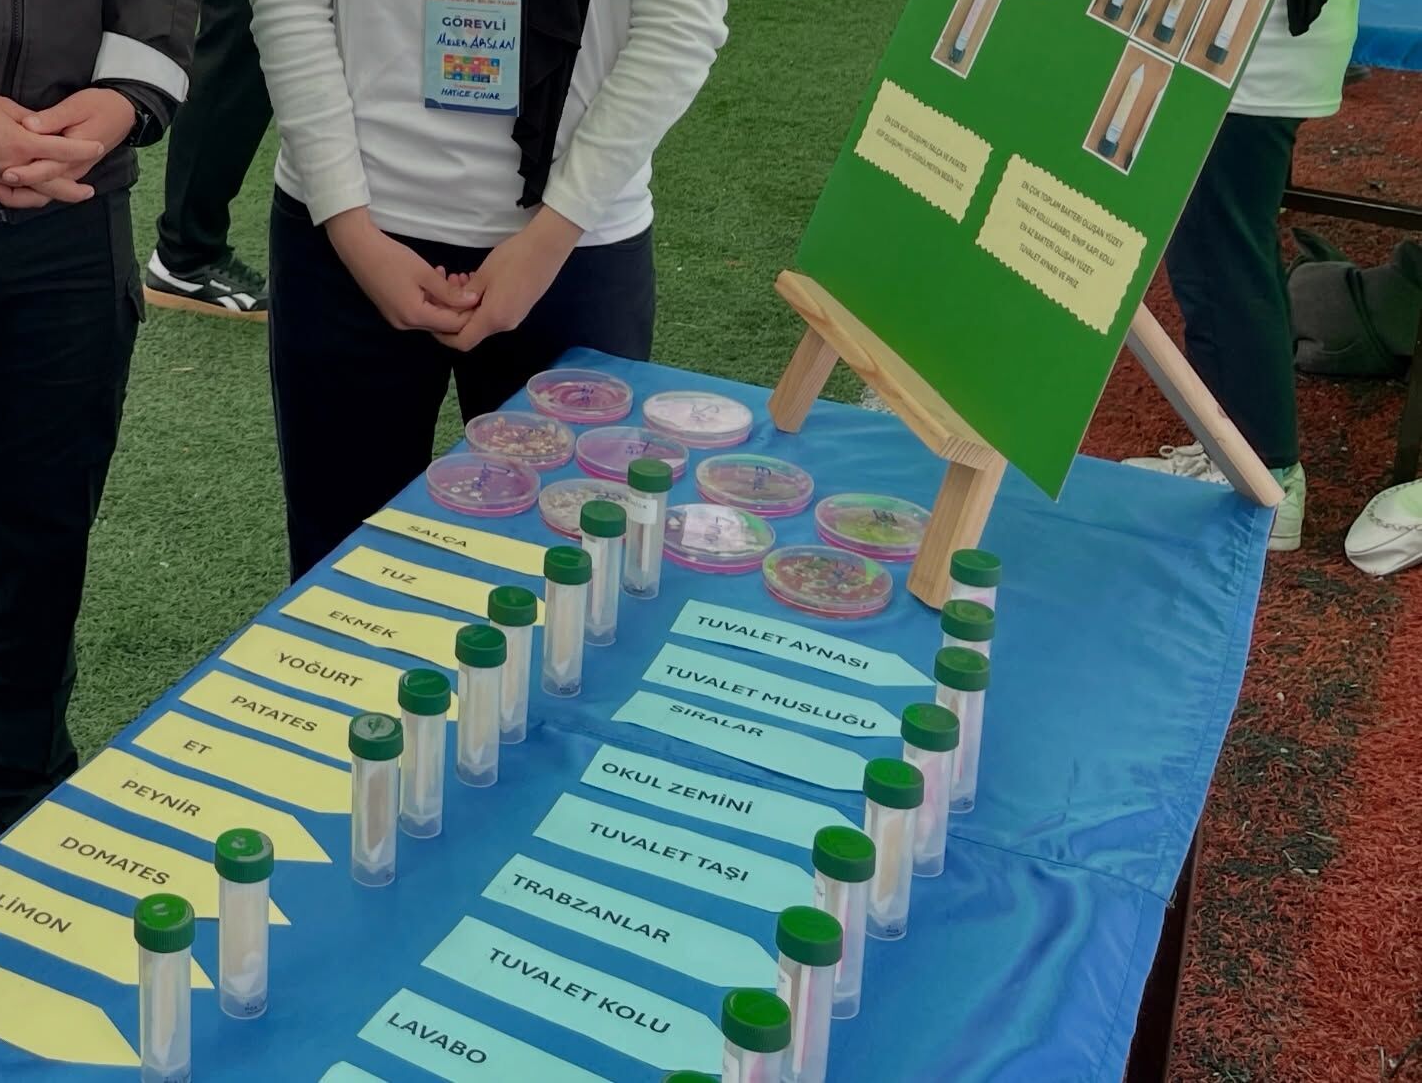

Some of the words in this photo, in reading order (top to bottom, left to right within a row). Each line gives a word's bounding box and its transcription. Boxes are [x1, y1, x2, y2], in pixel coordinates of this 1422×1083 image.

[441, 15, 506, 31] GÖREVLİ
[407, 524, 468, 549] SALÇA
[380, 565, 418, 585] TUZ
[327, 609, 399, 640] EKMEK
[697, 615, 787, 647] TUVALET
[788, 636, 869, 671] AYNASI
[277, 650, 364, 688] YOĞURT
[230, 694, 319, 734] PATATES
[664, 664, 759, 698] TUVALET
[761, 691, 877, 731] MUSLUĞU
[669, 703, 765, 737] SIRALAR
[182, 739, 213, 756] ET
[120, 778, 202, 818] PEYNİR
[601, 762, 663, 791] OKUL
[668, 780, 754, 815] ZEMİNİ
[59, 835, 172, 886] DOMATES
[589, 821, 693, 863] TUVALET
[695, 854, 750, 883] TAŞI
[511, 873, 671, 944] TRABZANLAR
[489, 947, 598, 1004] TUVALET
[597, 996, 672, 1036] KOLU
[386, 1012, 489, 1066] LAVABO
